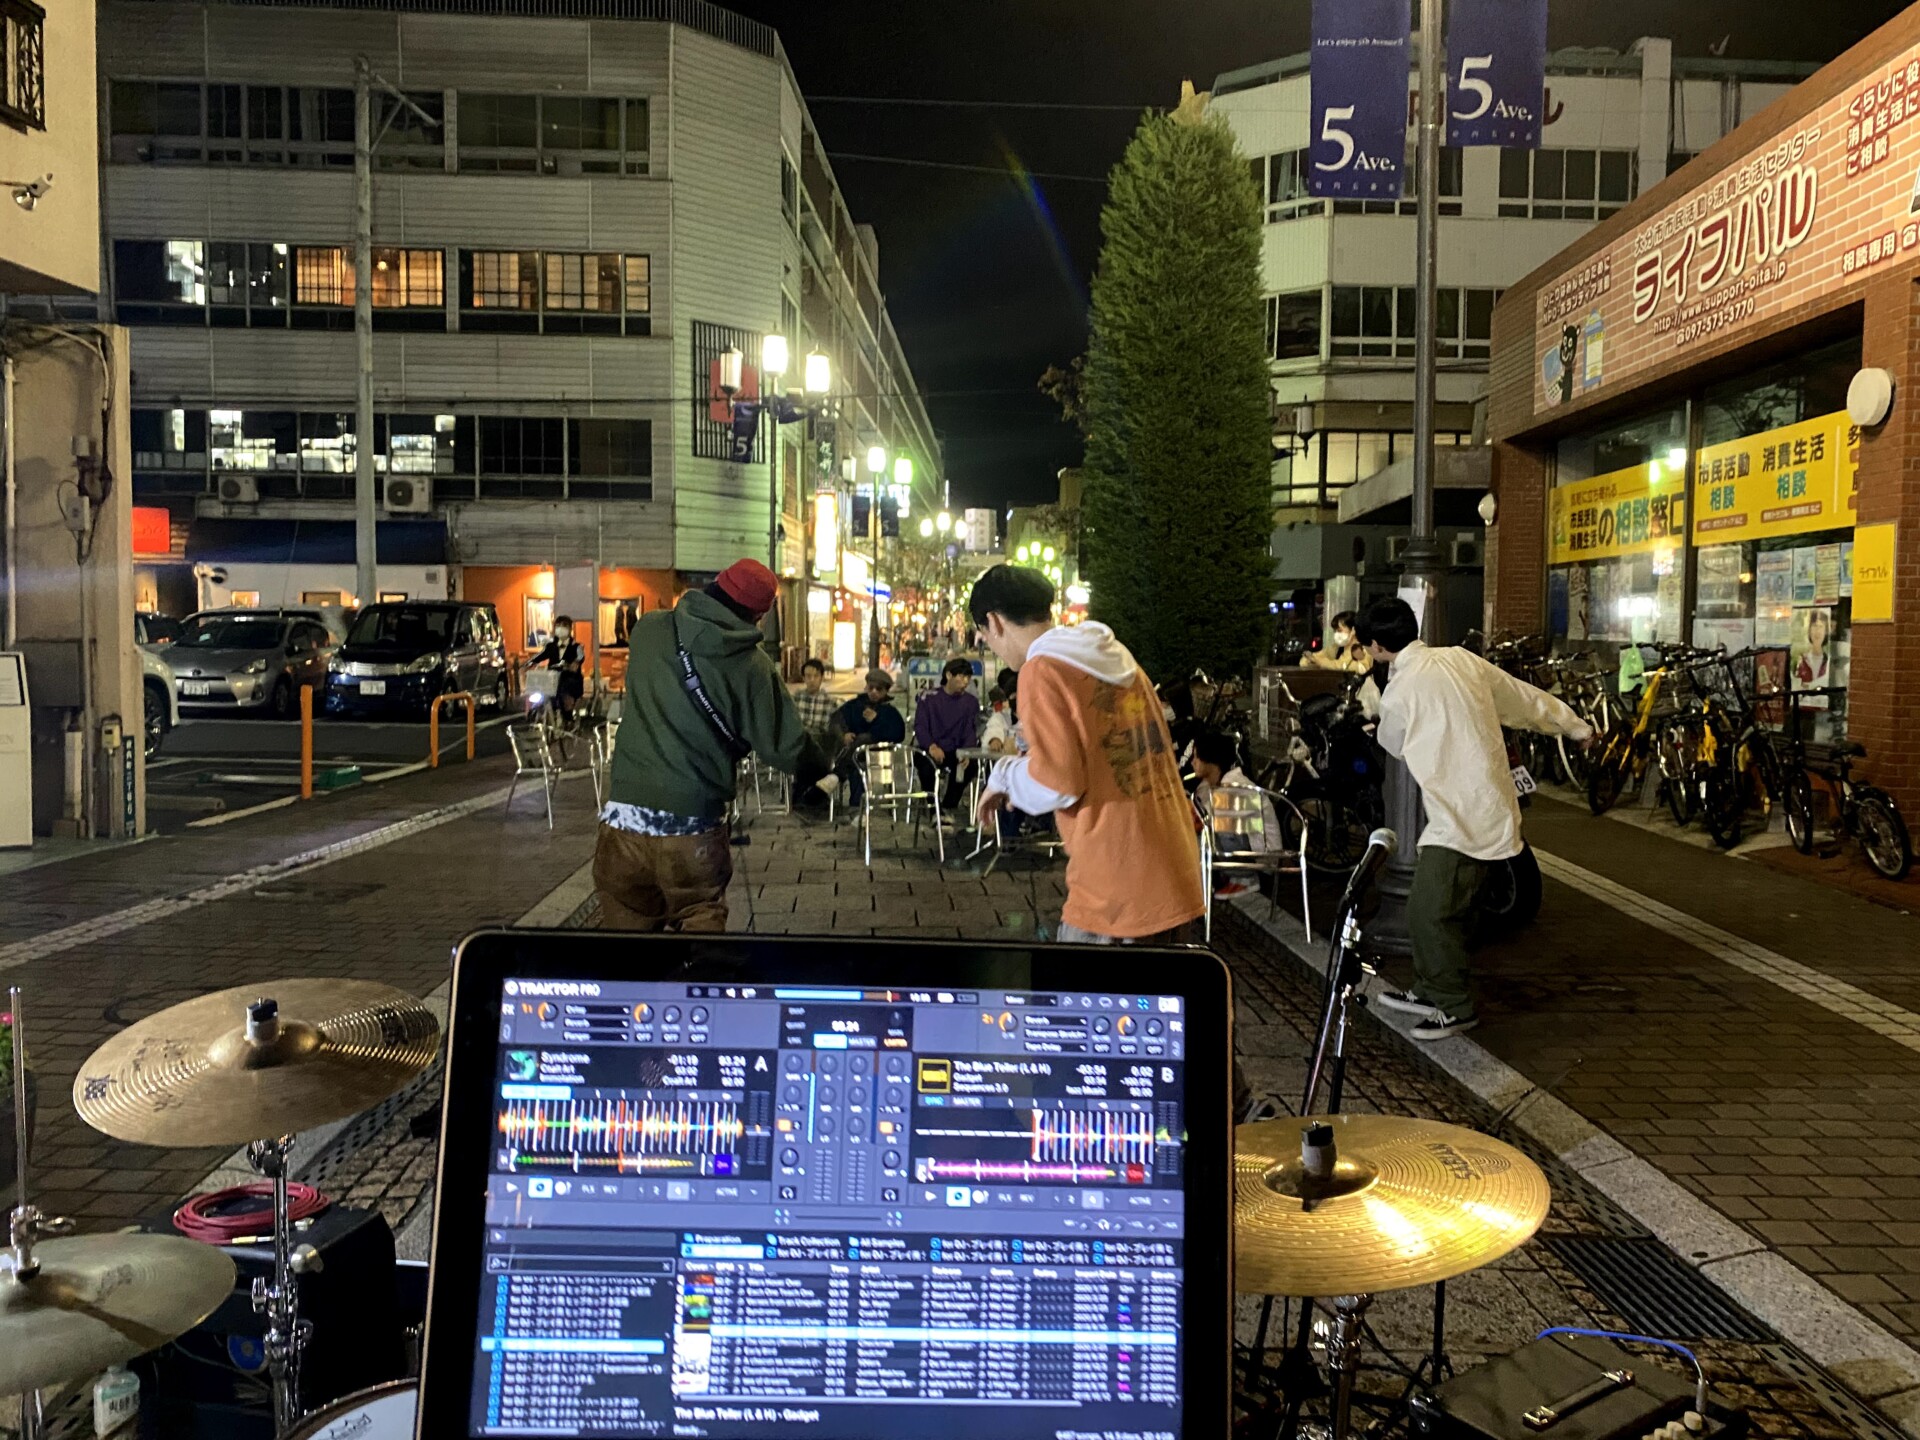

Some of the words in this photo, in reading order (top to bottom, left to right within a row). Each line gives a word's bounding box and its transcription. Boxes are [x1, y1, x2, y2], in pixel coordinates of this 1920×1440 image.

[1452, 53, 1493, 120] 5
[1493, 98, 1533, 121] Ave.
[1315, 104, 1355, 172] 5
[1353, 151, 1396, 171] Ave.
[1846, 134, 1889, 177] ご相談
[1633, 164, 1819, 324] ライフパル
[1842, 230, 1897, 274] 相談専用
[1653, 260, 1787, 335] http://www.support-oita.jp
[1684, 299, 1755, 342] 097-573-3770
[736, 436, 748, 456] 5
[1762, 433, 1825, 472] 消費生活
[1698, 452, 1750, 485] 市民活動
[1776, 470, 1807, 500] 相談
[1710, 484, 1735, 511] 相談
[1570, 508, 1598, 529] 市民活動
[1569, 530, 1598, 551] 消費生活
[519, 982, 580, 996] TRAKTOR
[580, 983, 601, 996] PRO
[541, 1052, 590, 1065] Syndrome
[755, 1056, 769, 1072] A
[1161, 1068, 1174, 1083] B
[695, 1234, 741, 1244] Preparation
[777, 1236, 800, 1246] Track
[801, 1237, 841, 1247] Collection
[870, 1239, 906, 1249] Samples
[674, 1407, 693, 1420] The
